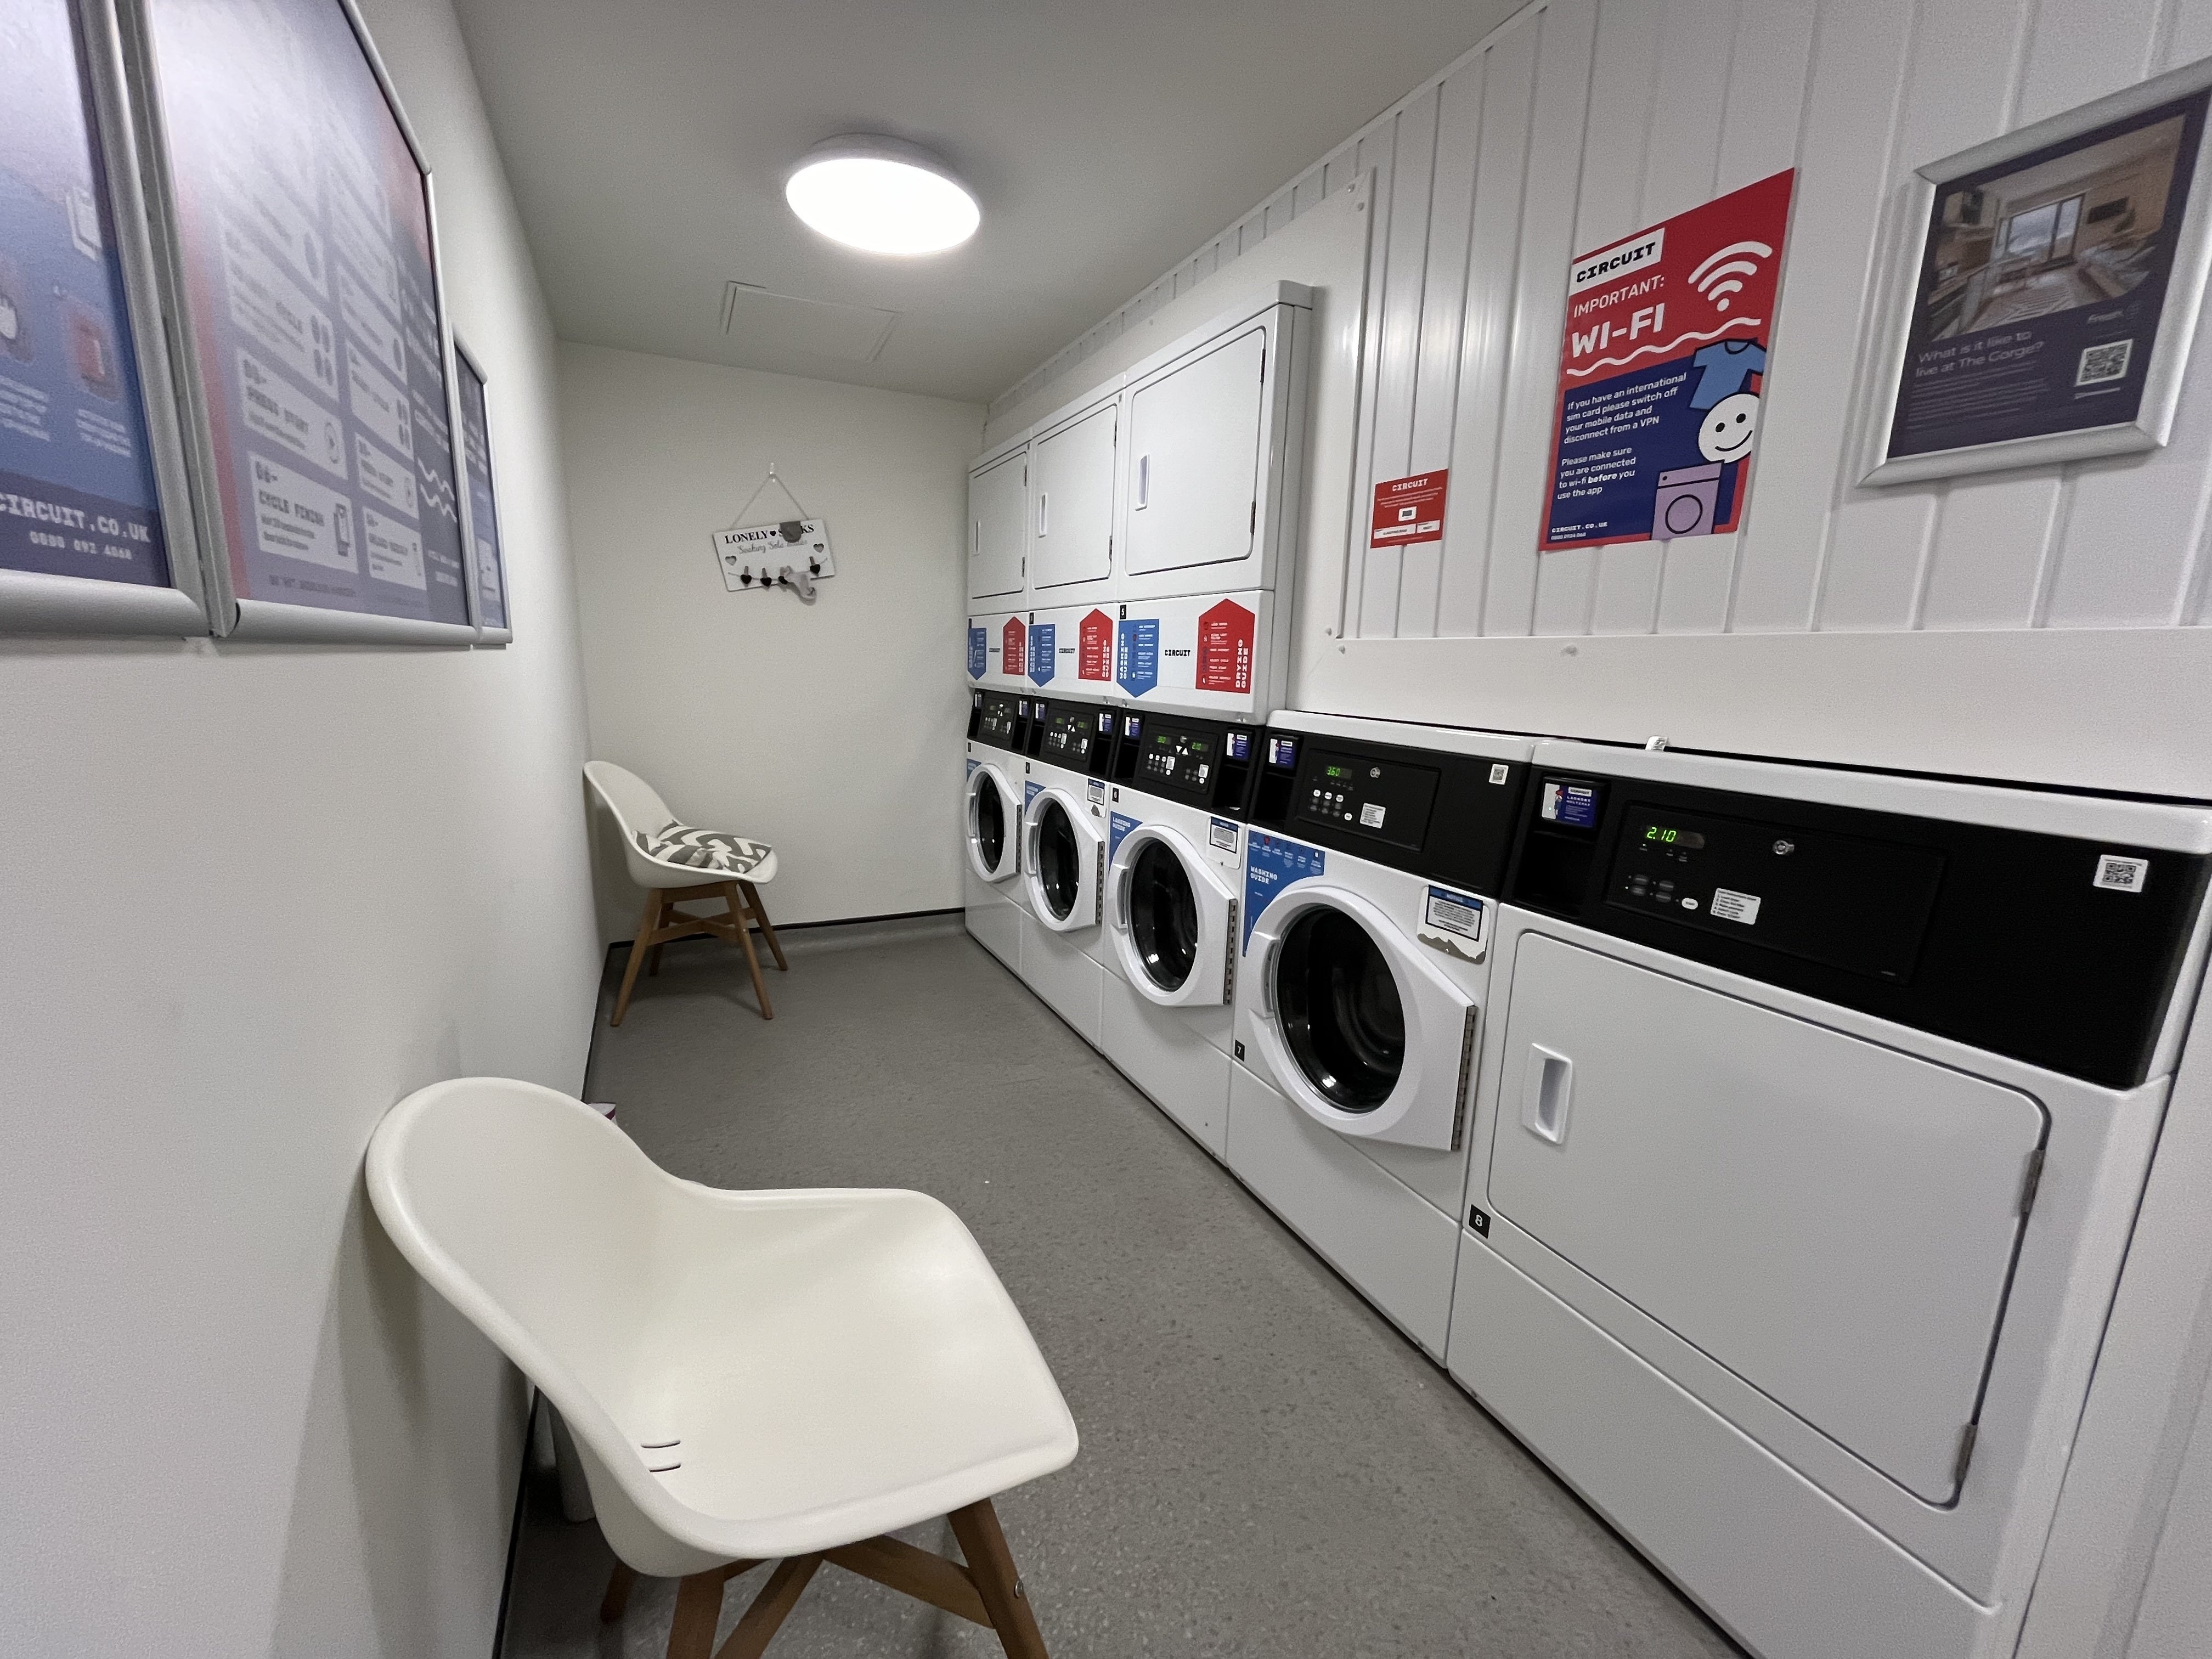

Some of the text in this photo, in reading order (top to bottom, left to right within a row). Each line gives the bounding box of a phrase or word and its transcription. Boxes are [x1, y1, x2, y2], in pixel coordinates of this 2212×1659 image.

[1577, 242, 1655, 282] CIRCUIT
[1574, 275, 1664, 318] IMPORTANT:
[1572, 303, 1664, 358] WI-FI
[1919, 348, 1956, 363] What
[1916, 366, 1938, 377] live
[1940, 363, 1955, 372] at
[1959, 357, 1985, 368] The
[1567, 373, 1686, 410] If you have an international
[1582, 407, 1600, 417] card
[1602, 400, 1629, 414] please
[1632, 392, 1662, 406] switch
[1664, 386, 1679, 398] off
[1565, 405, 1652, 434] your mobile data and
[1564, 427, 1609, 444] disconnect
[1610, 424, 1630, 434] from
[1640, 416, 1660, 426] VPN
[1562, 447, 1632, 466] Please make sure
[1560, 470, 1574, 479] you
[1591, 456, 1636, 472] connected
[1392, 478, 1428, 492] CIRCUIT
[1569, 477, 1587, 487] wi-fi
[1588, 472, 1617, 483] before
[1619, 470, 1635, 479] you
[1573, 488, 1585, 496] the
[1587, 487, 1602, 495] app
[725, 524, 814, 544] LONELY SKS
[1551, 521, 1608, 533] CIRCUIT.CO.UK
[1646, 827, 1677, 842] 2.10
[1250, 873, 1269, 884] GUIDE
[1251, 866, 1277, 881] WASHING
[1238, 1046, 1241, 1054] 7
[1475, 1215, 1482, 1226] 8
